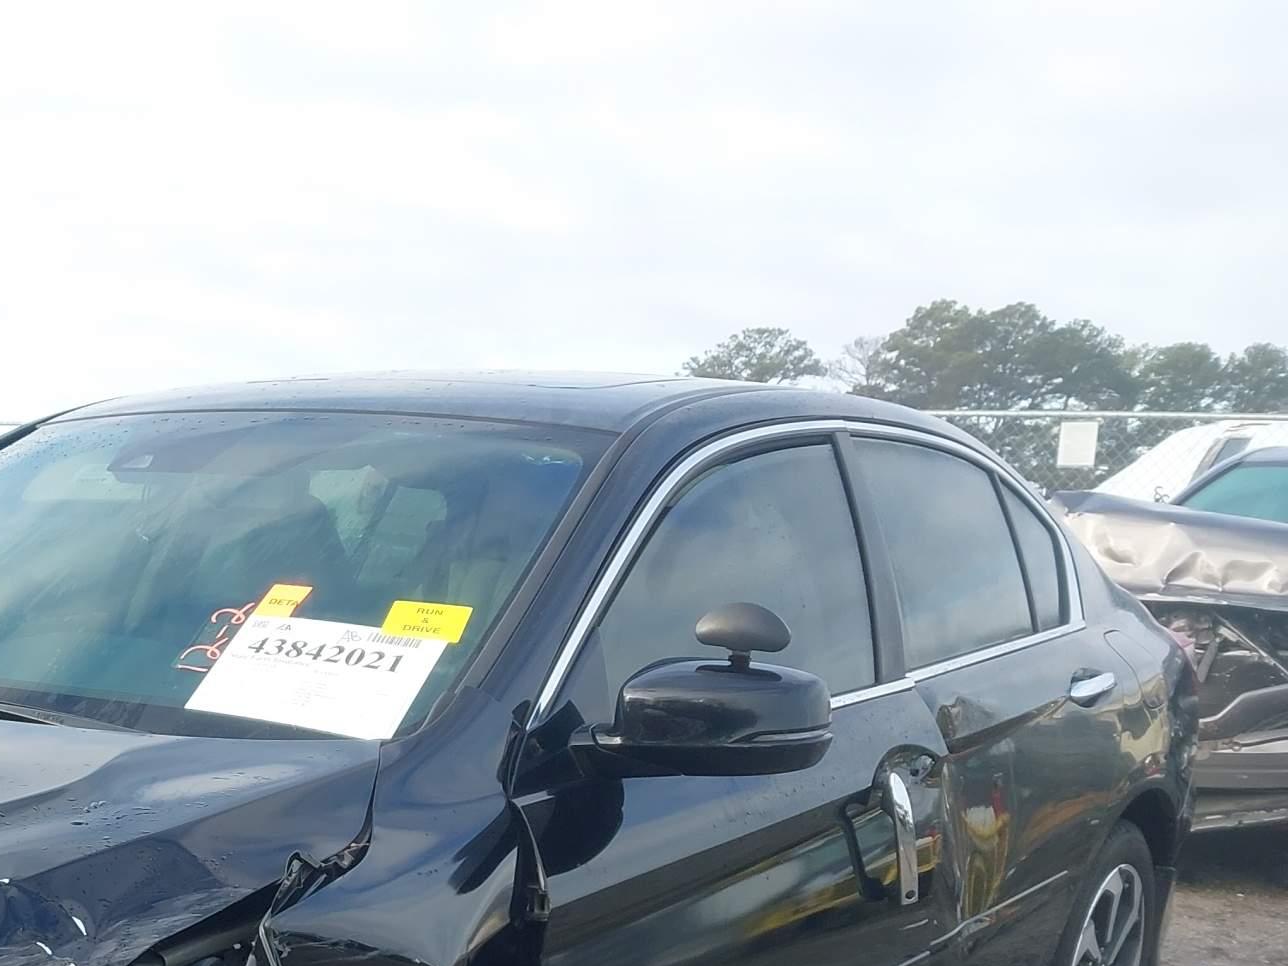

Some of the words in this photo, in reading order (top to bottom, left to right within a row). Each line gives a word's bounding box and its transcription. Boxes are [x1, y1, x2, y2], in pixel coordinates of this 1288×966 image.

[416, 607, 444, 616] RUN
[401, 624, 441, 635] DRIVE
[247, 637, 404, 673] 43842021
